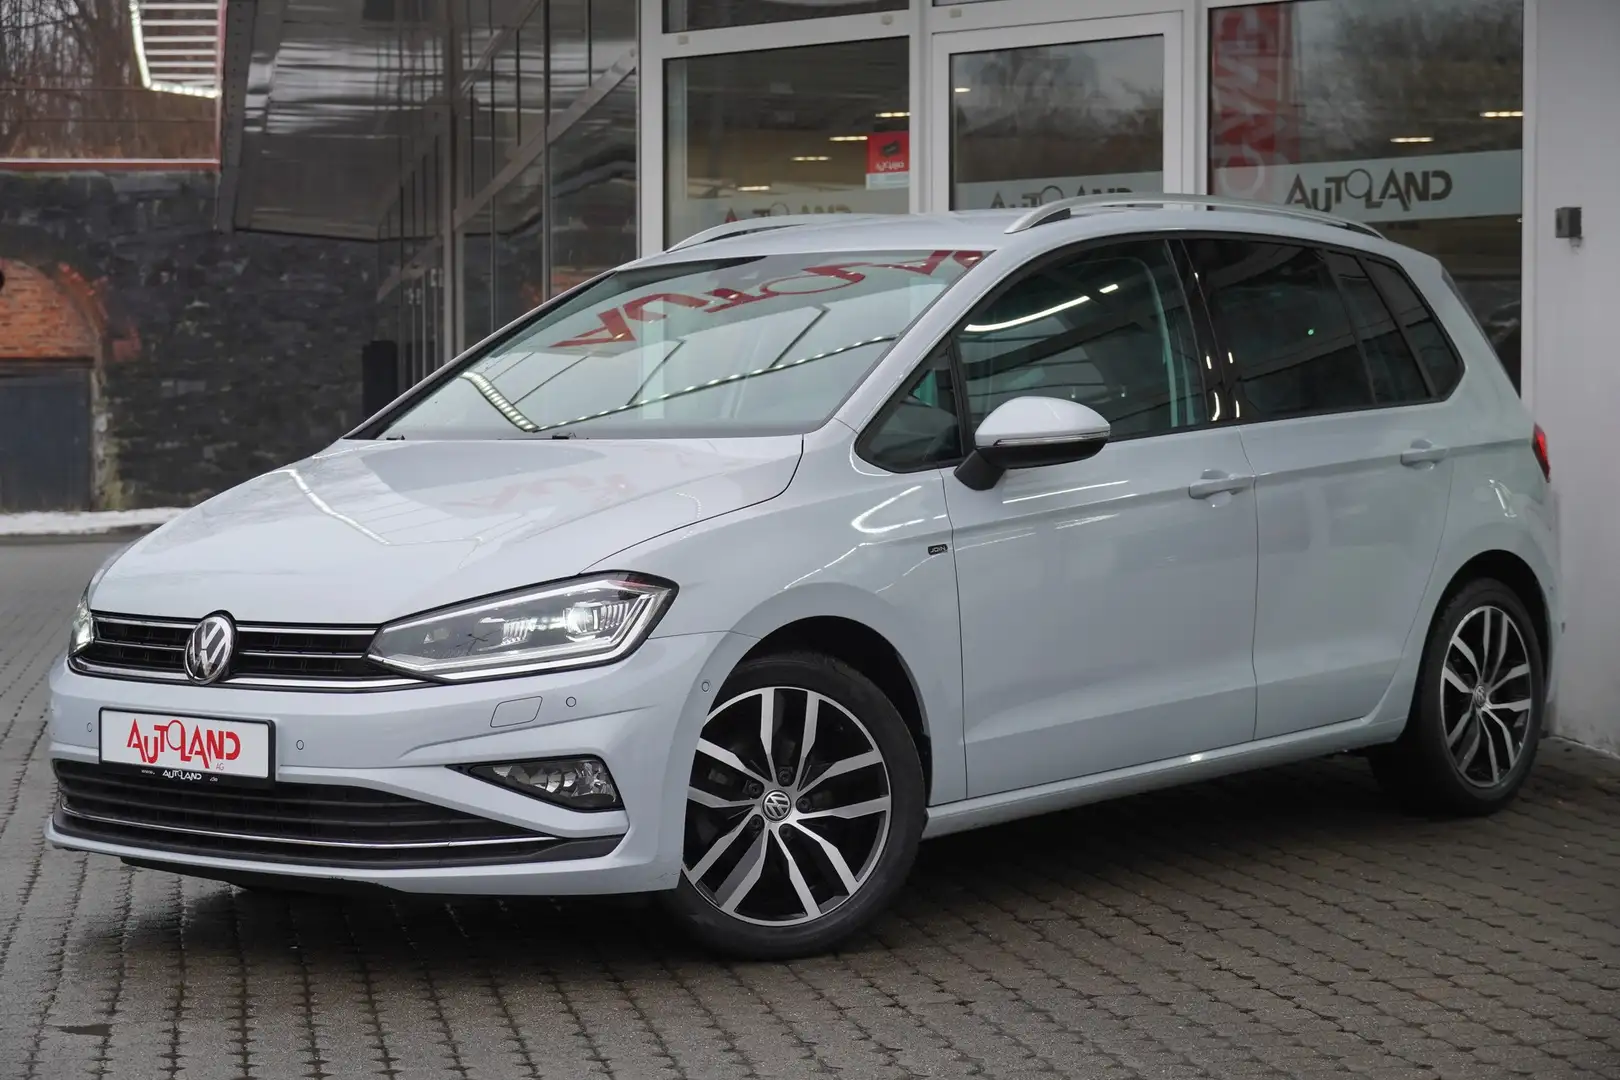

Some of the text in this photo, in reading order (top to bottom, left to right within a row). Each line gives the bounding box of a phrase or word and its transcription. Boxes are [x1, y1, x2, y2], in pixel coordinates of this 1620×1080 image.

[1284, 168, 1453, 213] AUTOLAND
[126, 718, 241, 769] AUTOLAND
[162, 769, 202, 781] AUTOLAND
[216, 763, 225, 771] AG
